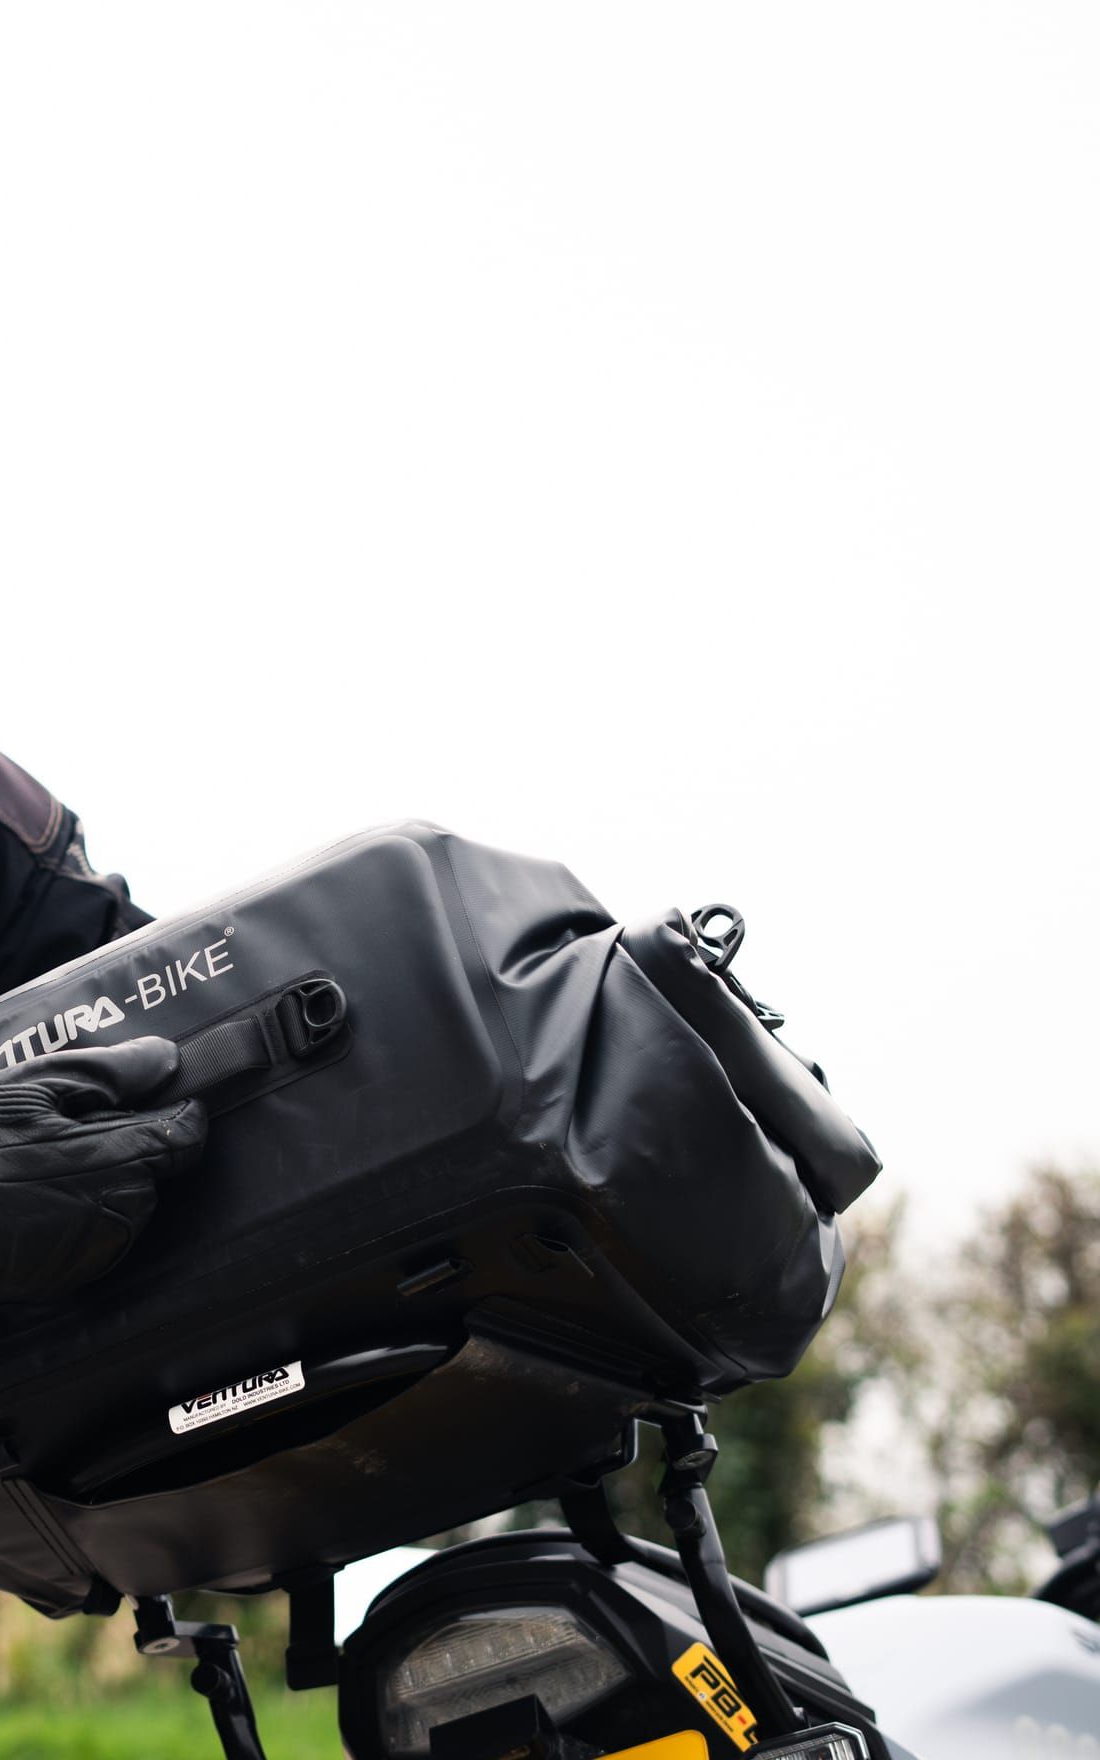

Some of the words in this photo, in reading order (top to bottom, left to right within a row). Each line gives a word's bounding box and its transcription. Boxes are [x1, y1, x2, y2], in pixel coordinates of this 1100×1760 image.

[181, 1368, 289, 1414] VENTURA
[248, 1383, 279, 1399] INDUSTRIES
[279, 1379, 290, 1387] LTD
